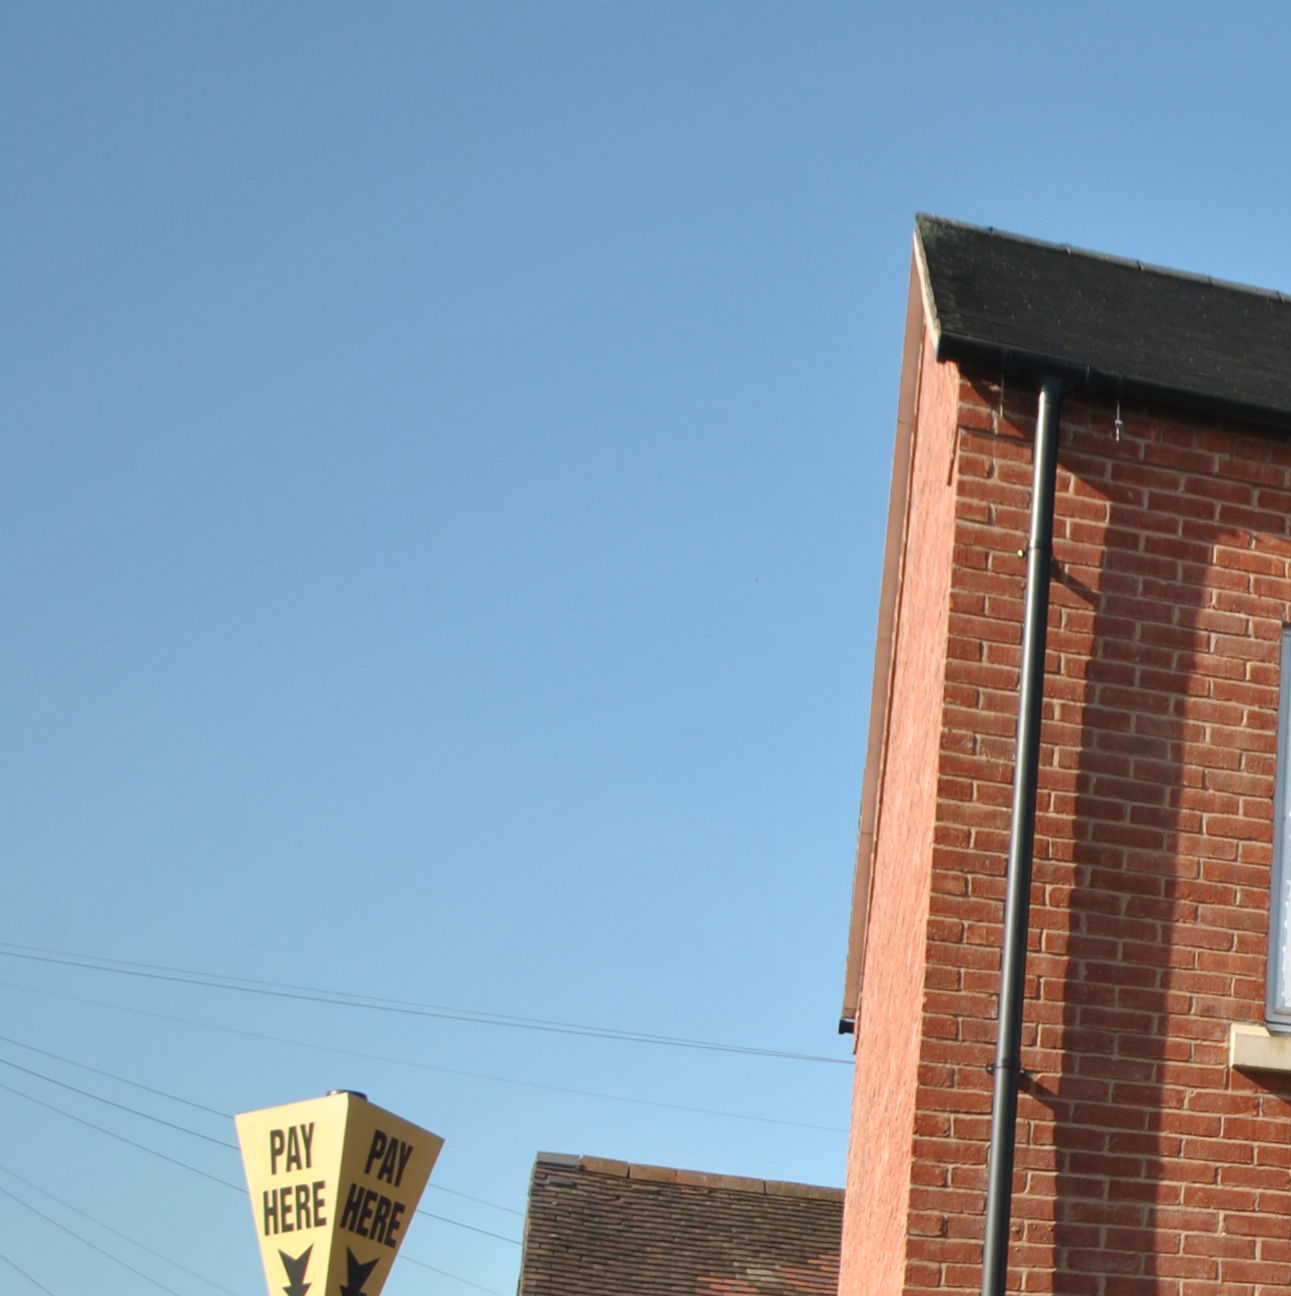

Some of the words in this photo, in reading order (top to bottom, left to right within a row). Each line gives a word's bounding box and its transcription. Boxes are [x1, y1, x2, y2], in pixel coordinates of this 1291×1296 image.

[269, 1121, 315, 1176] PAY
[364, 1129, 413, 1187] PAY
[262, 1180, 327, 1237] HERE
[340, 1183, 405, 1248] HERE
